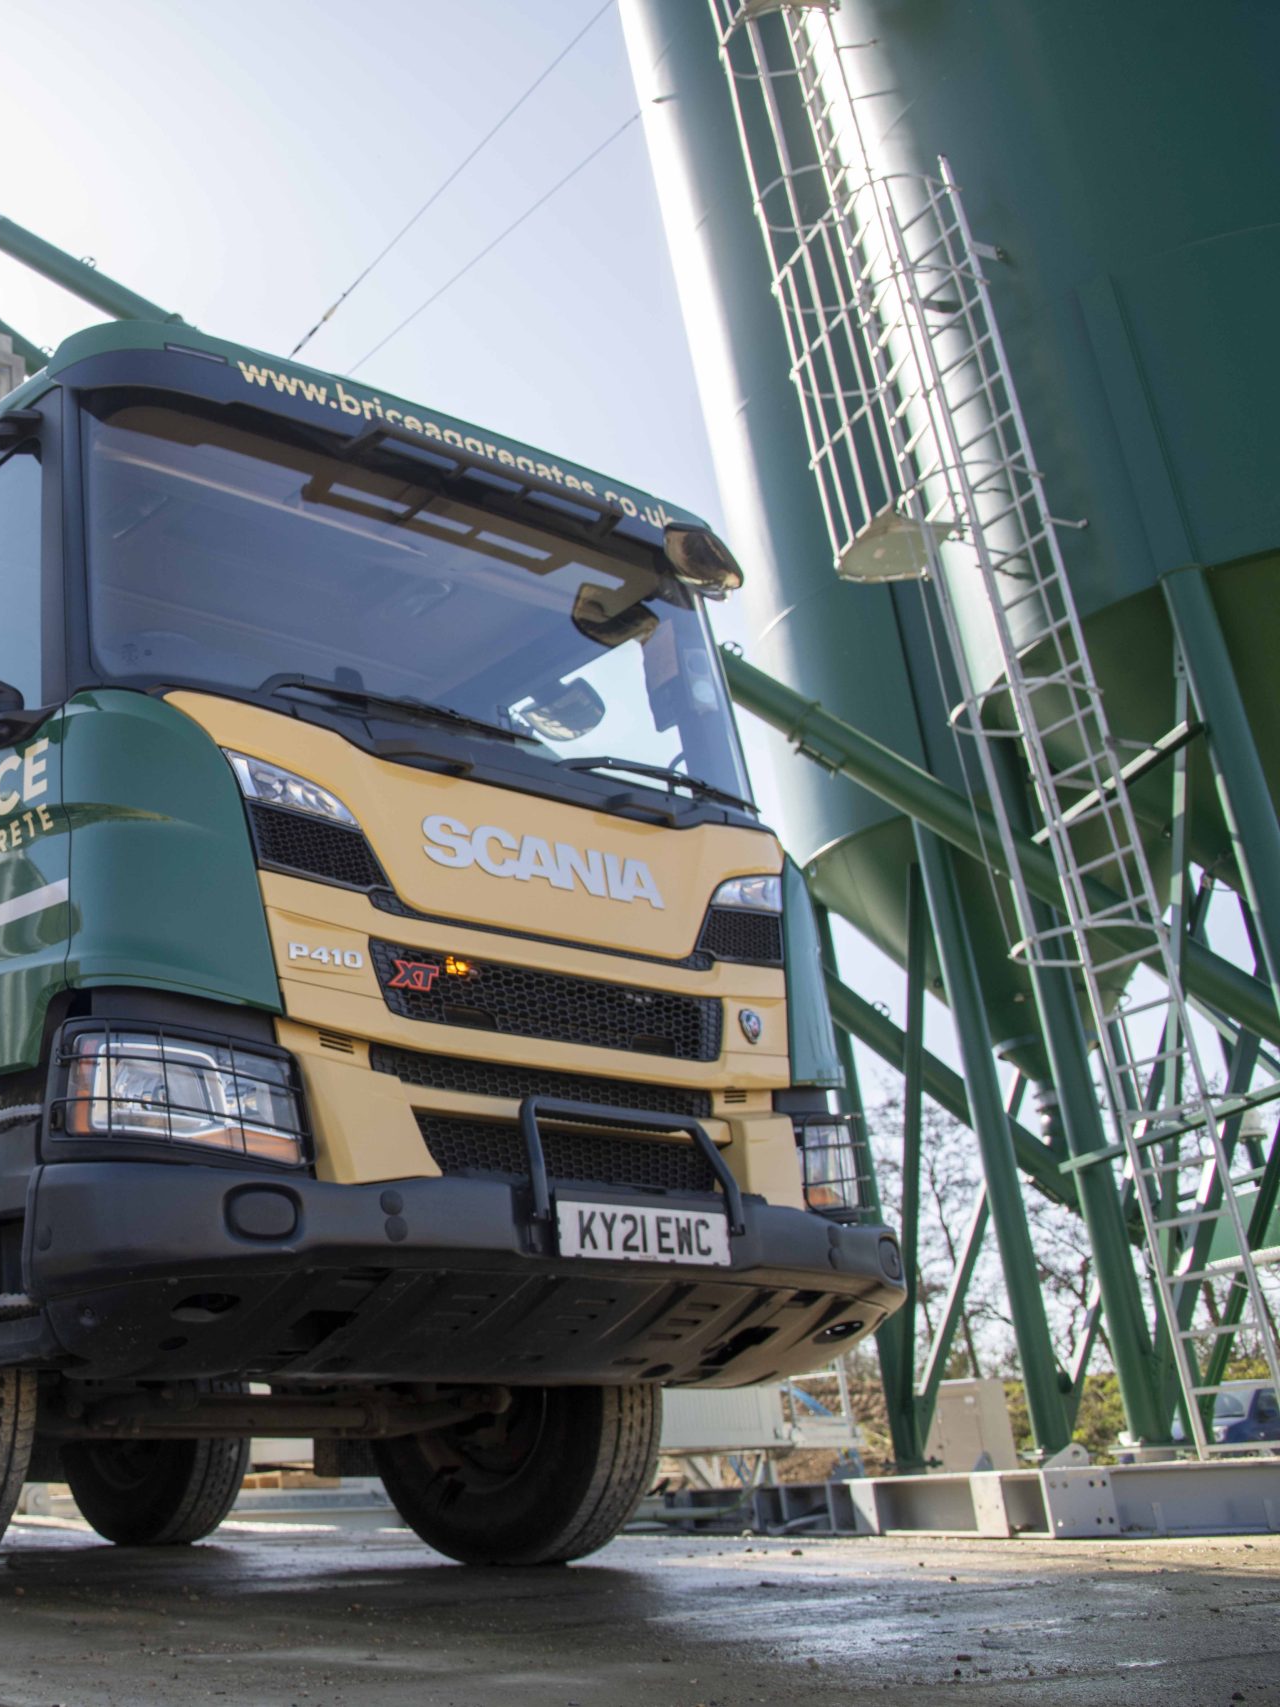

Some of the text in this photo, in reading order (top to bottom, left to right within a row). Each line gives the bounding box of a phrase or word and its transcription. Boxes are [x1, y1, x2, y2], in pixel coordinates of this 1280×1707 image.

[237, 359, 673, 530] www.briceaggregatesco.uk
[422, 815, 665, 909] SCANIA
[288, 942, 363, 969] P410
[388, 959, 440, 992] XT
[578, 1210, 712, 1256] KY21 EWC
